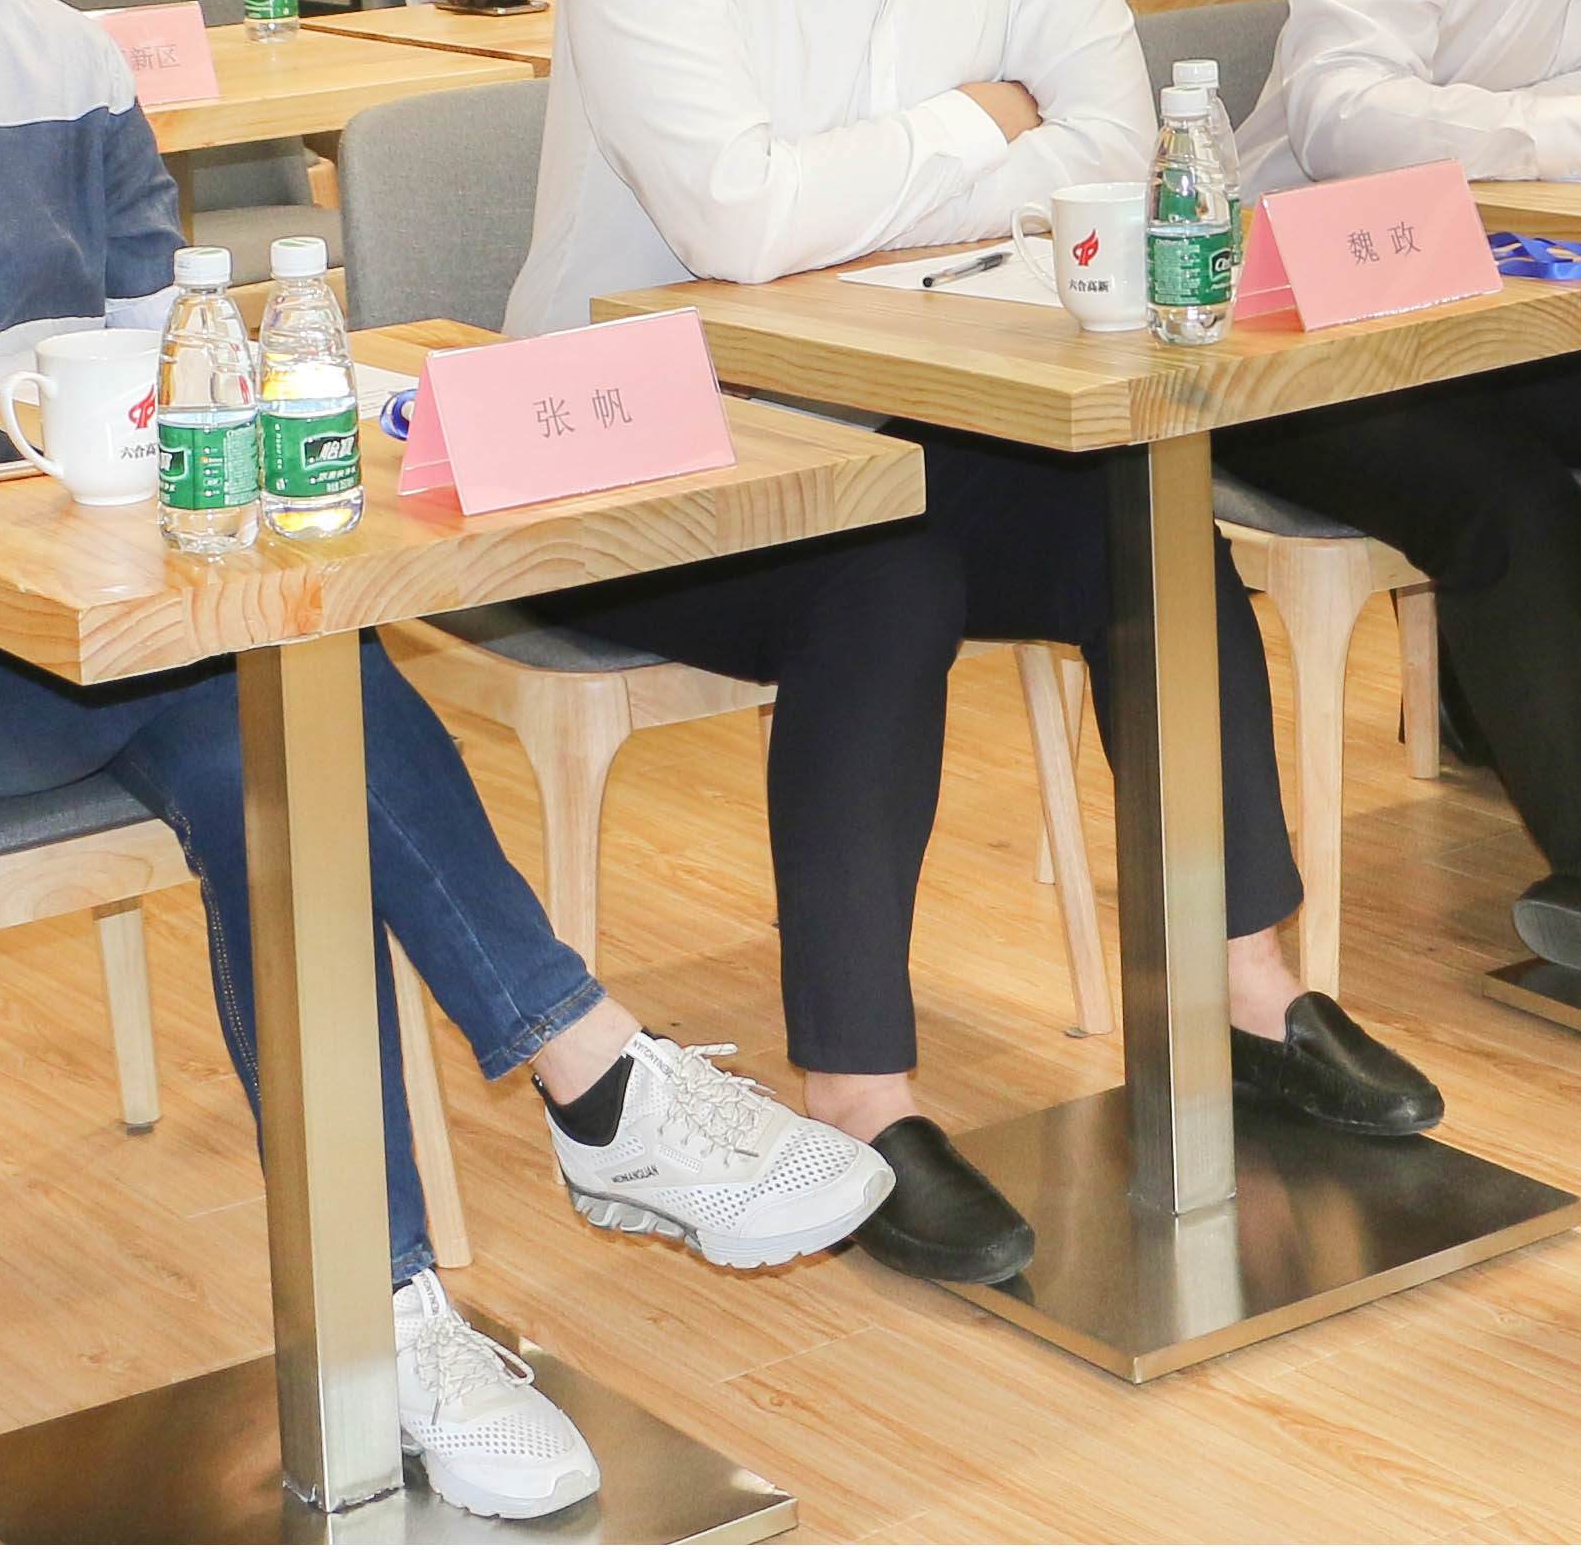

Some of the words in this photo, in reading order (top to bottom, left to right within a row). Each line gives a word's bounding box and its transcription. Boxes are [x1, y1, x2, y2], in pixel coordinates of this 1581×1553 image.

[121, 44, 181, 70] 新区
[1347, 220, 1422, 267] 魏政
[532, 387, 633, 439] 张帆
